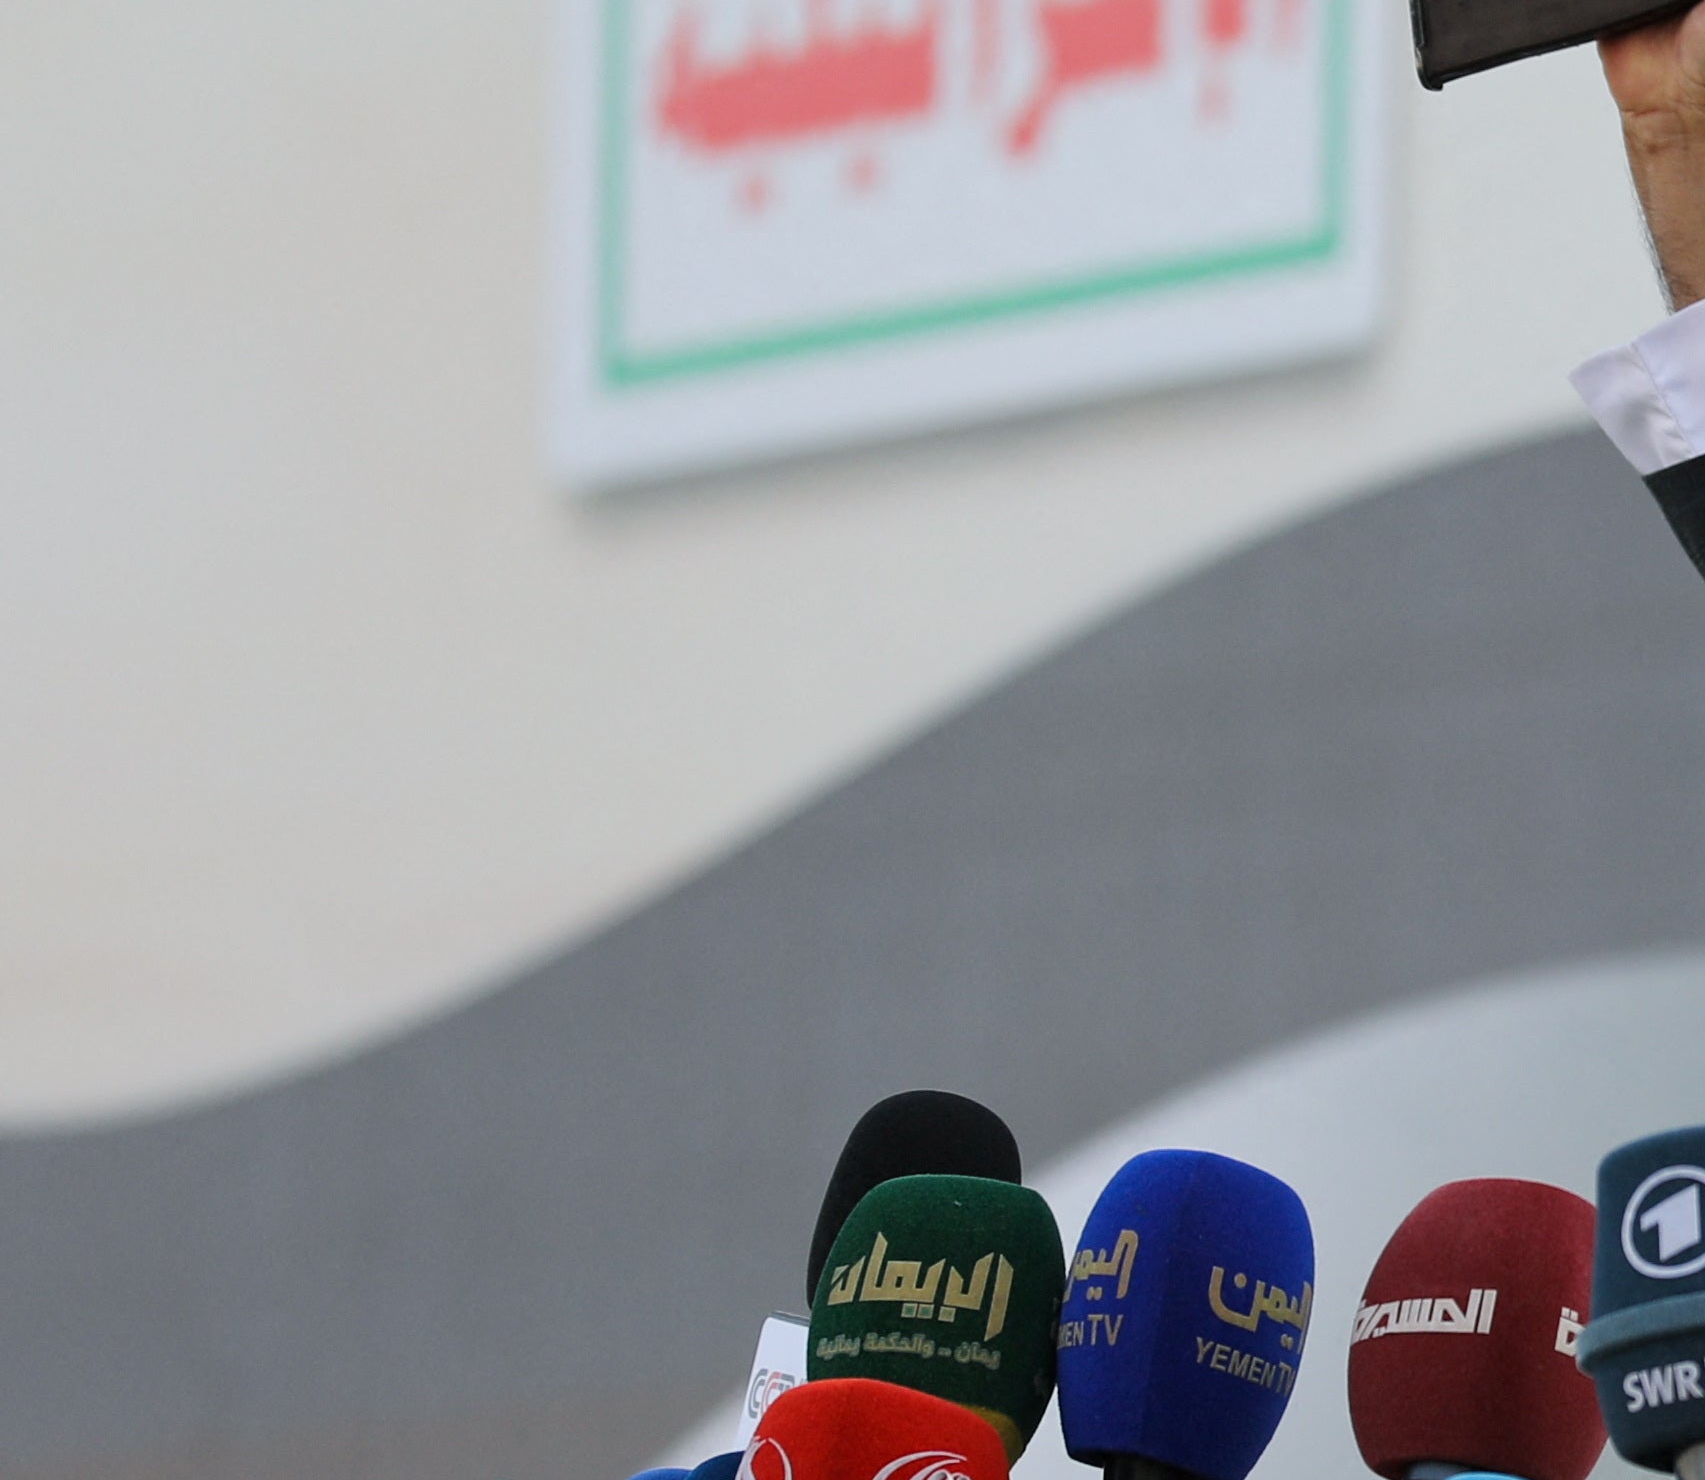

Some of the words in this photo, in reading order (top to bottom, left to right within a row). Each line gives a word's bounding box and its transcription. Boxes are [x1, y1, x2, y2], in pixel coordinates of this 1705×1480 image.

[1087, 1314, 1124, 1347] TV
[1196, 1336, 1276, 1390] YEMEN
[1622, 1359, 1705, 1414] SWR
